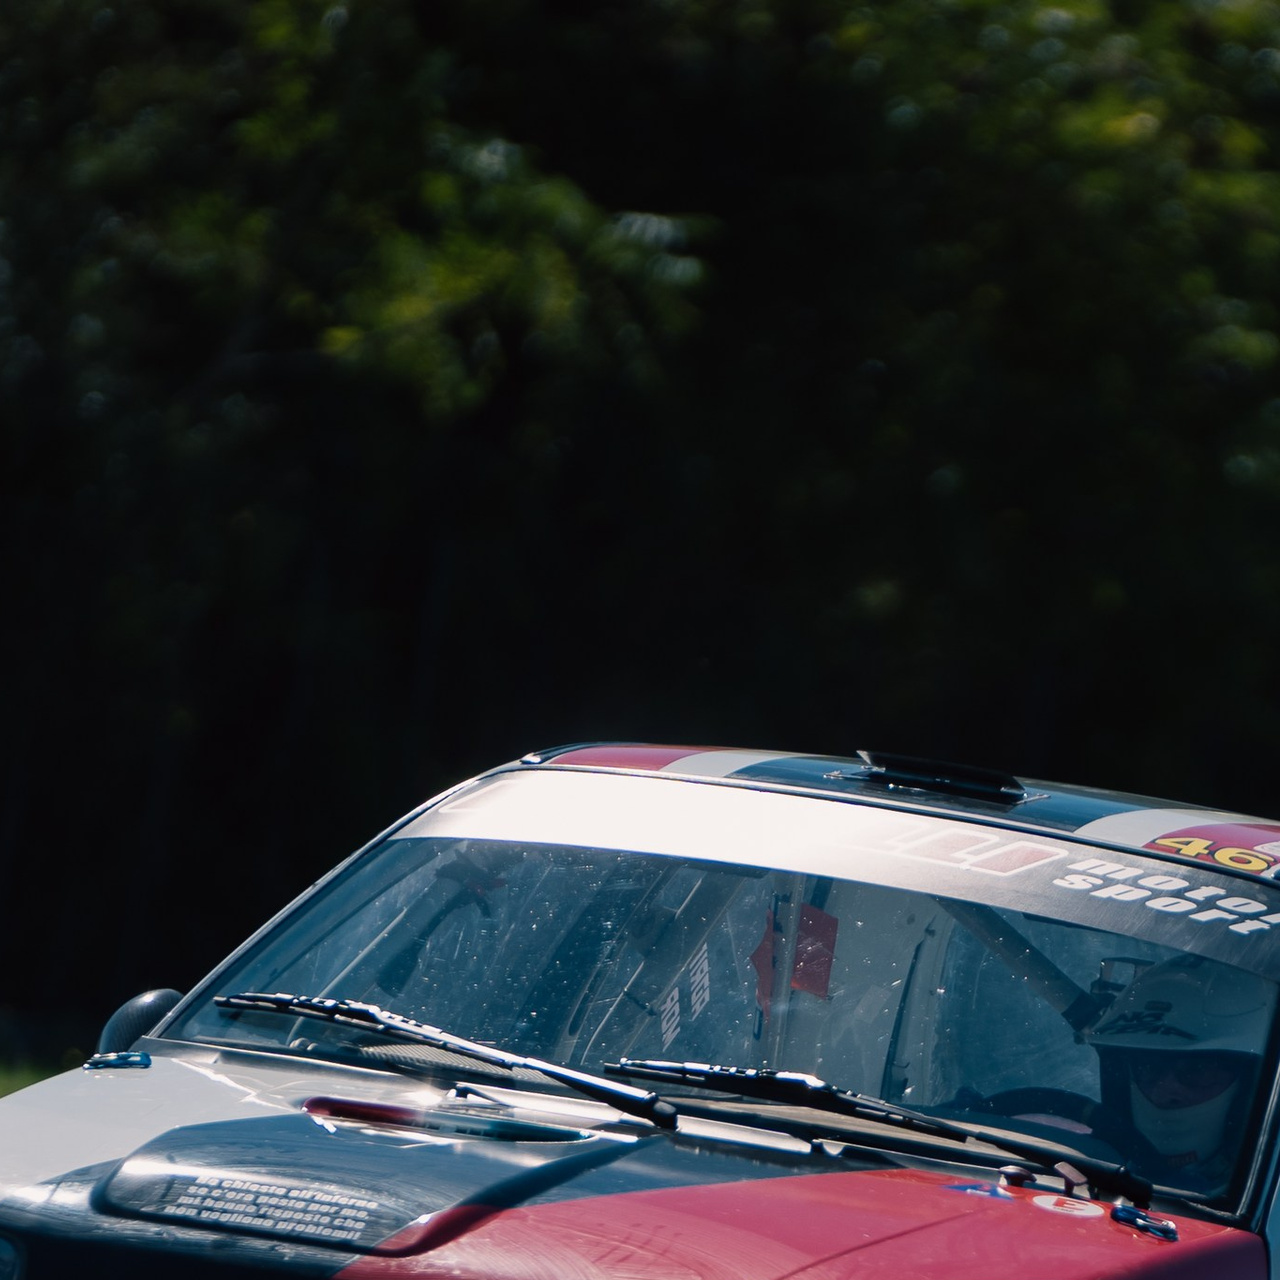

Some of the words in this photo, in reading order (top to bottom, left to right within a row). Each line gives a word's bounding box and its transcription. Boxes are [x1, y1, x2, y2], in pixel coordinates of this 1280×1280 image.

[1153, 837, 1275, 872] 46
[1053, 874, 1271, 935] sport
[221, 1178, 287, 1195] chiesto
[164, 1205, 199, 1216] non
[200, 1210, 275, 1227] vogliono
[202, 1197, 257, 1213] hanno
[258, 1206, 331, 1224] risposto
[332, 1218, 366, 1229] che
[255, 1195, 306, 1209] posto
[307, 1202, 339, 1213] per
